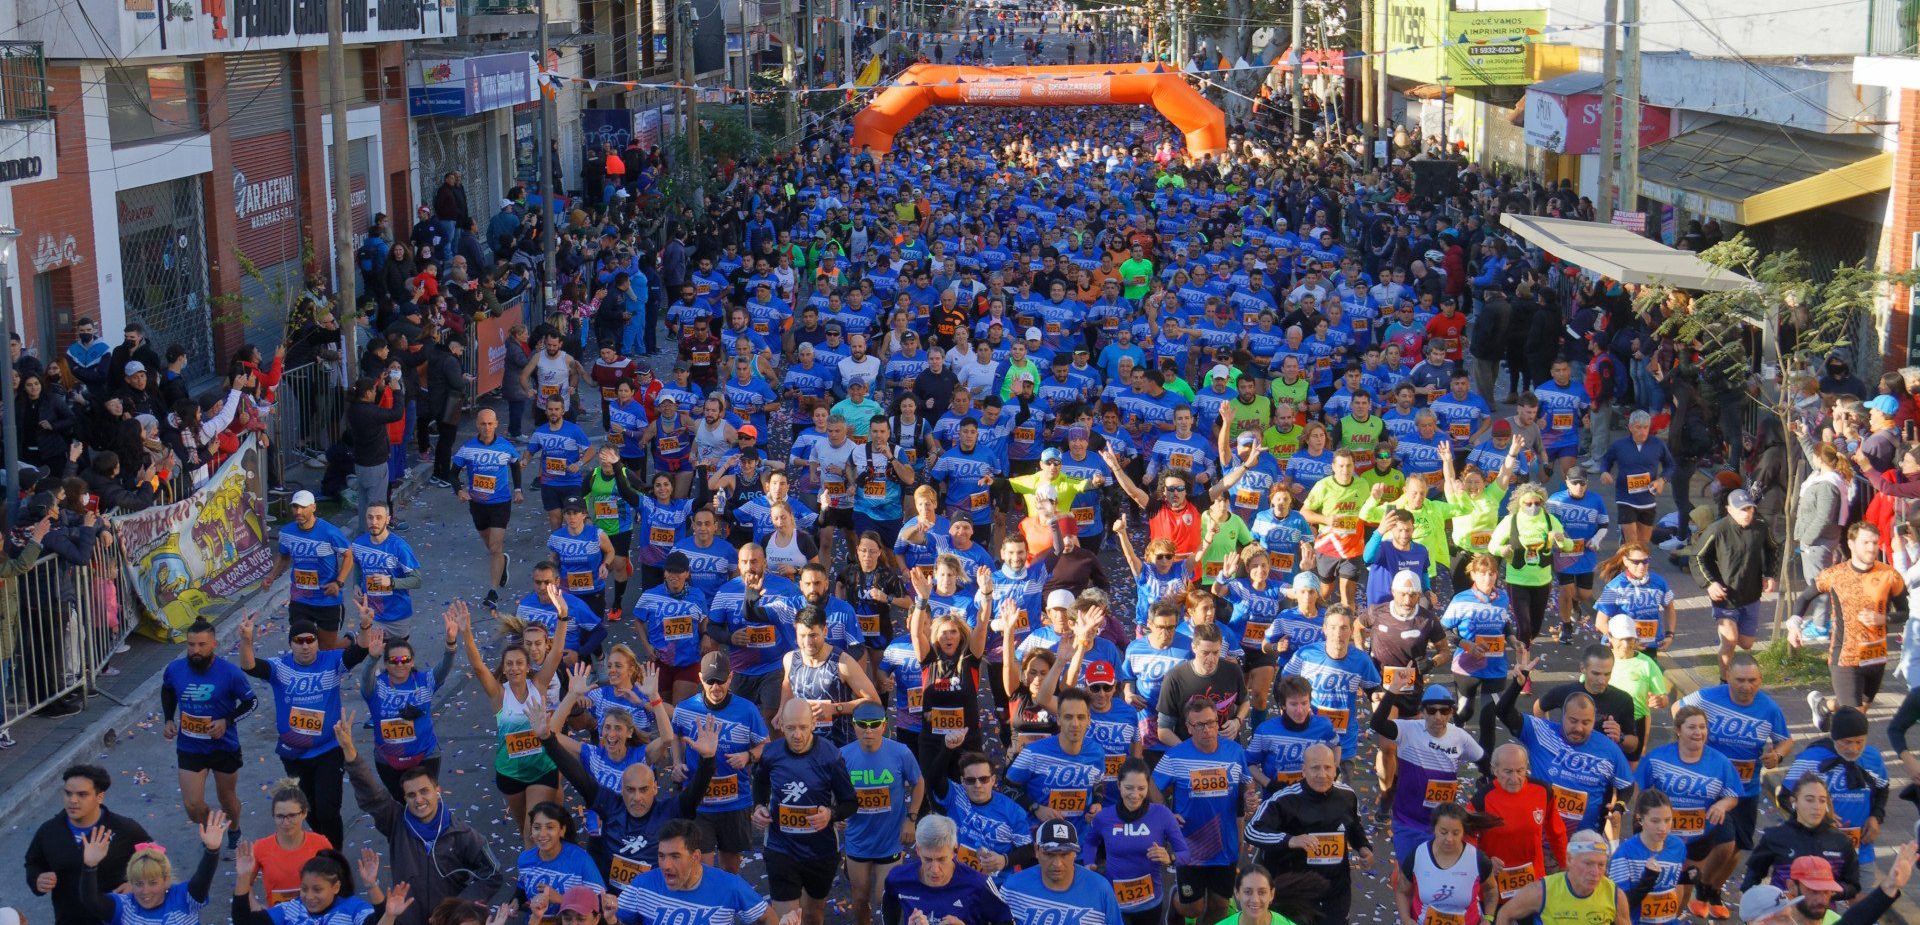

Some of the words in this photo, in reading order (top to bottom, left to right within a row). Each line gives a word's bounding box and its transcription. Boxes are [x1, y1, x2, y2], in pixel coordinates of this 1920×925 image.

[1187, 292, 1208, 303] 10K
[751, 307, 773, 318] 10K
[846, 316, 867, 326] 10K
[1208, 334, 1231, 344] 10K
[1255, 336, 1275, 346] 10K
[900, 362, 923, 373] 10K
[794, 377, 818, 387] 10K
[726, 392, 753, 403] 10K
[1051, 390, 1076, 400] 10K
[1548, 397, 1575, 408] 10K
[1143, 408, 1169, 419] 10K
[1445, 408, 1471, 418] 10K
[1390, 424, 1414, 434] 10K
[541, 438, 567, 449] 10K
[472, 453, 502, 465] 10K
[1407, 447, 1437, 460] 10K
[1171, 457, 1191, 467] 1874
[1297, 461, 1324, 473] 10K
[953, 463, 981, 475] 10K
[474, 479, 494, 489] 3033
[864, 485, 884, 495] 2077
[974, 497, 987, 505] 249
[602, 506, 611, 514] 15
[1561, 508, 1589, 521] 10K
[1267, 528, 1293, 541] 10K
[289, 541, 319, 555] 10K
[560, 542, 588, 555] 10K
[360, 553, 388, 567] 10K
[690, 557, 718, 570] 10K
[295, 574, 318, 585] 2873
[655, 601, 696, 615] 10K
[1467, 609, 1506, 623] 10K
[666, 623, 692, 635] 3797
[751, 633, 771, 643] 696
[287, 673, 323, 693] 10K
[1313, 673, 1356, 691] 10K
[290, 716, 321, 730] 3169
[933, 717, 962, 729] 1886
[1710, 714, 1764, 739] 10K
[383, 725, 413, 739] 3170
[1089, 724, 1127, 742] 10K
[507, 737, 540, 750] 1960
[1553, 749, 1602, 774] 10K
[850, 770, 894, 784] FILA
[1044, 766, 1090, 786] 10K
[705, 783, 737, 796] 2698
[1192, 776, 1227, 790] 2988
[1662, 773, 1714, 797] 10K
[858, 795, 889, 808] 2697
[1427, 789, 1454, 801] 2651
[1051, 797, 1084, 810] 1597
[1672, 815, 1705, 829] 1219
[1113, 823, 1151, 836] FILA
[527, 876, 570, 897] 10K
[1500, 873, 1534, 890] 1559
[1117, 885, 1152, 899] 1321
[1644, 898, 1677, 916] 3749
[653, 906, 720, 925] 10K
[1024, 908, 1090, 925] 10K
